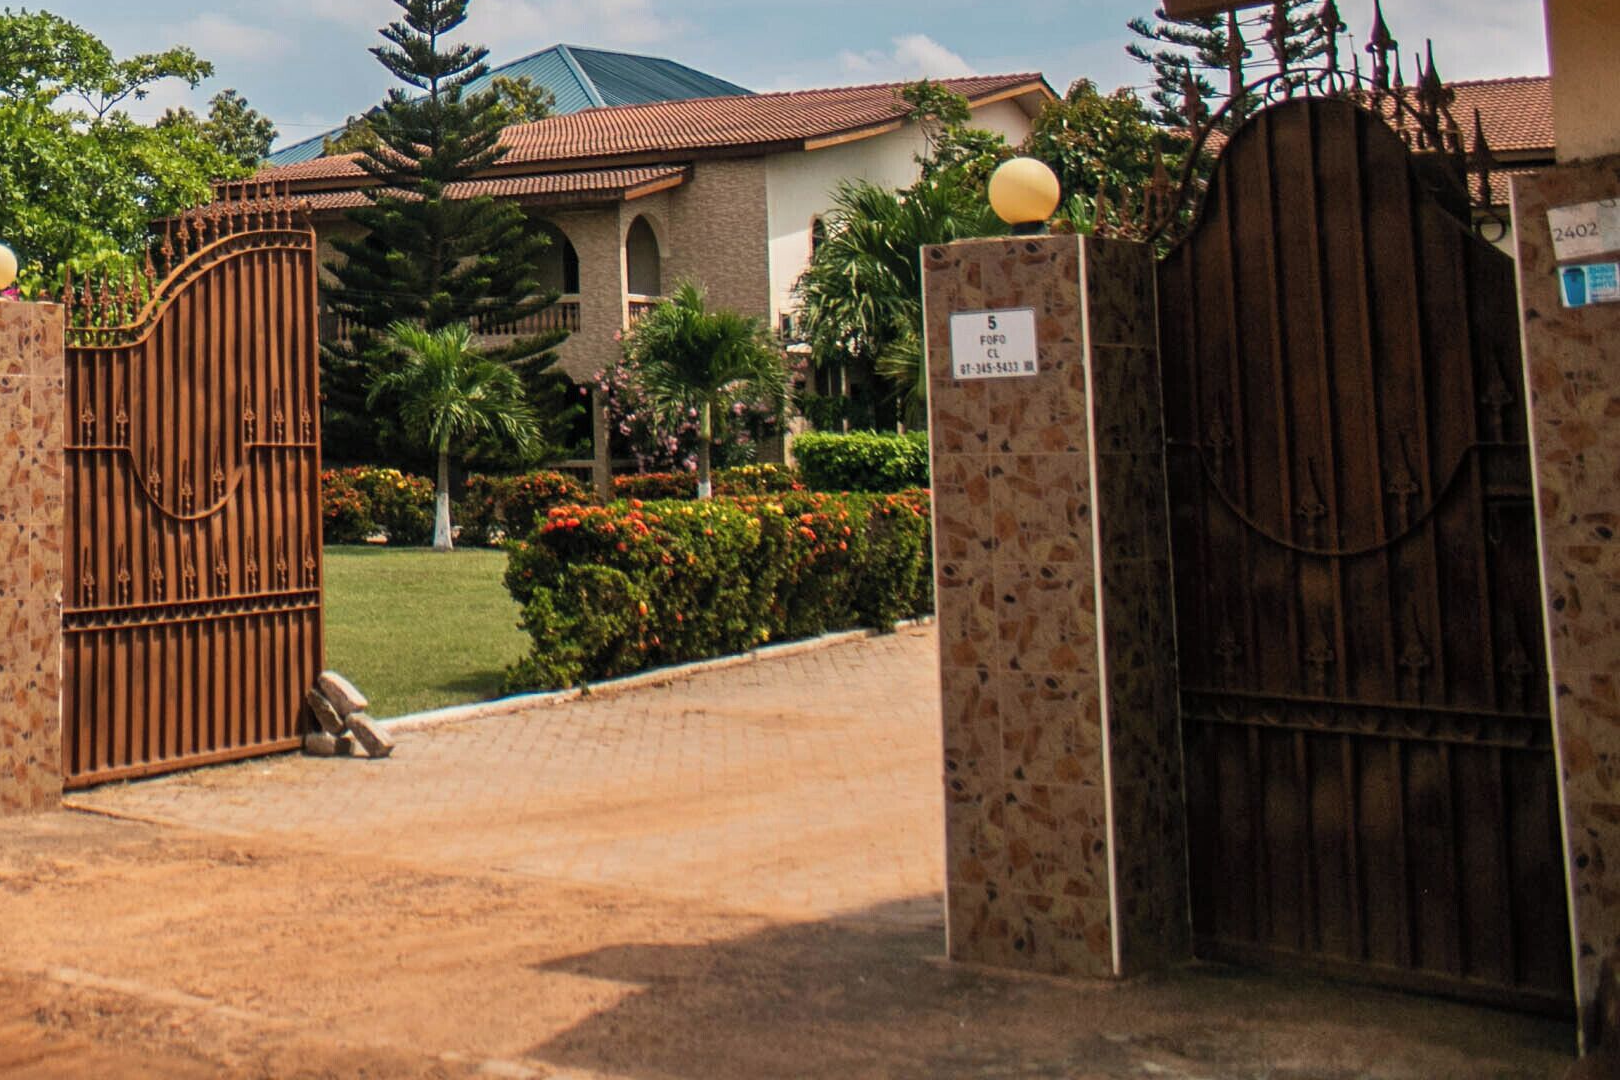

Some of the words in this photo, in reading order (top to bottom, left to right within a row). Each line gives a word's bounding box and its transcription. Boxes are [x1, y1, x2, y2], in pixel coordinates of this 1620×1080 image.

[1553, 223, 1599, 242] 2402
[988, 315, 996, 330] 5
[987, 349, 1000, 358] CL
